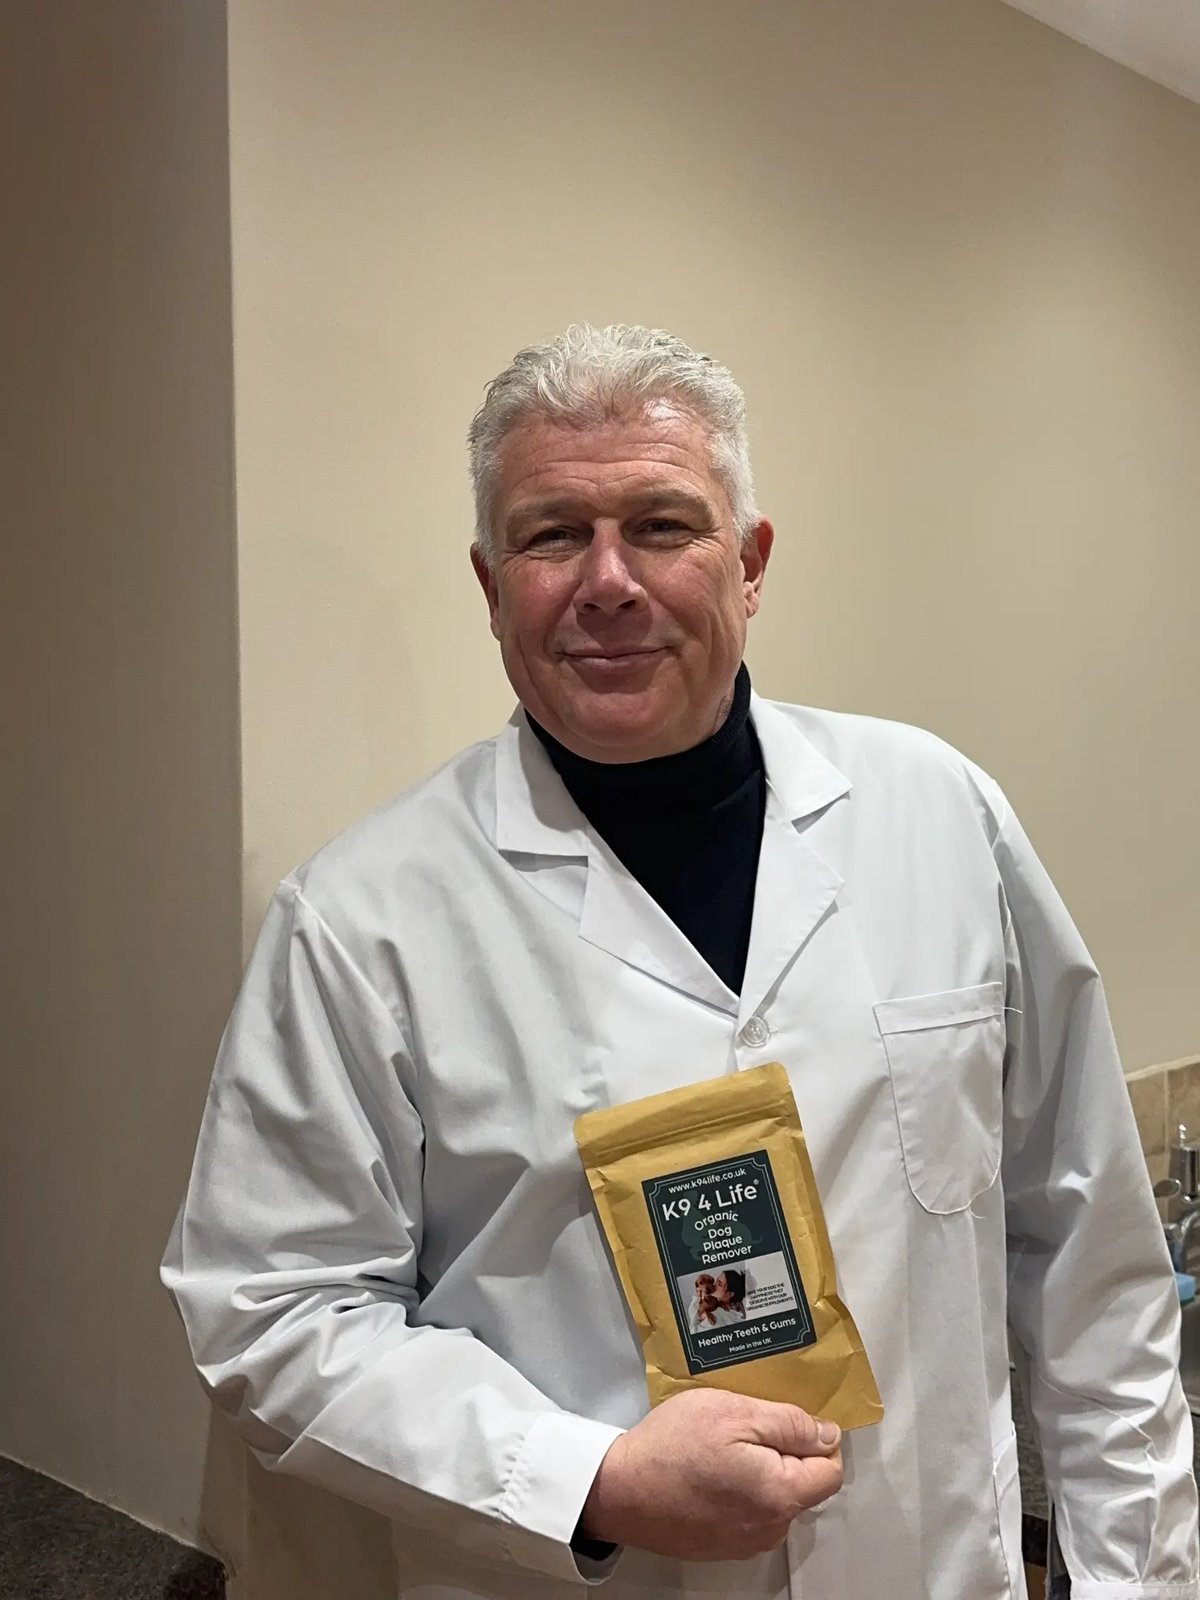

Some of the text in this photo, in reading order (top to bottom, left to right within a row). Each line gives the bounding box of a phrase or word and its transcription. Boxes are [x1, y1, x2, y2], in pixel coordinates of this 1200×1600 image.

[668, 1168, 746, 1194] www.k94life.co.uk
[662, 1198, 691, 1221] K9
[698, 1194, 711, 1210] 4
[708, 1225, 732, 1239] Dog
[702, 1244, 752, 1264] Remover
[703, 1236, 742, 1252] Plaque
[698, 1317, 796, 1348] Healthy Teeth & Gums
[729, 1344, 745, 1352] Made
